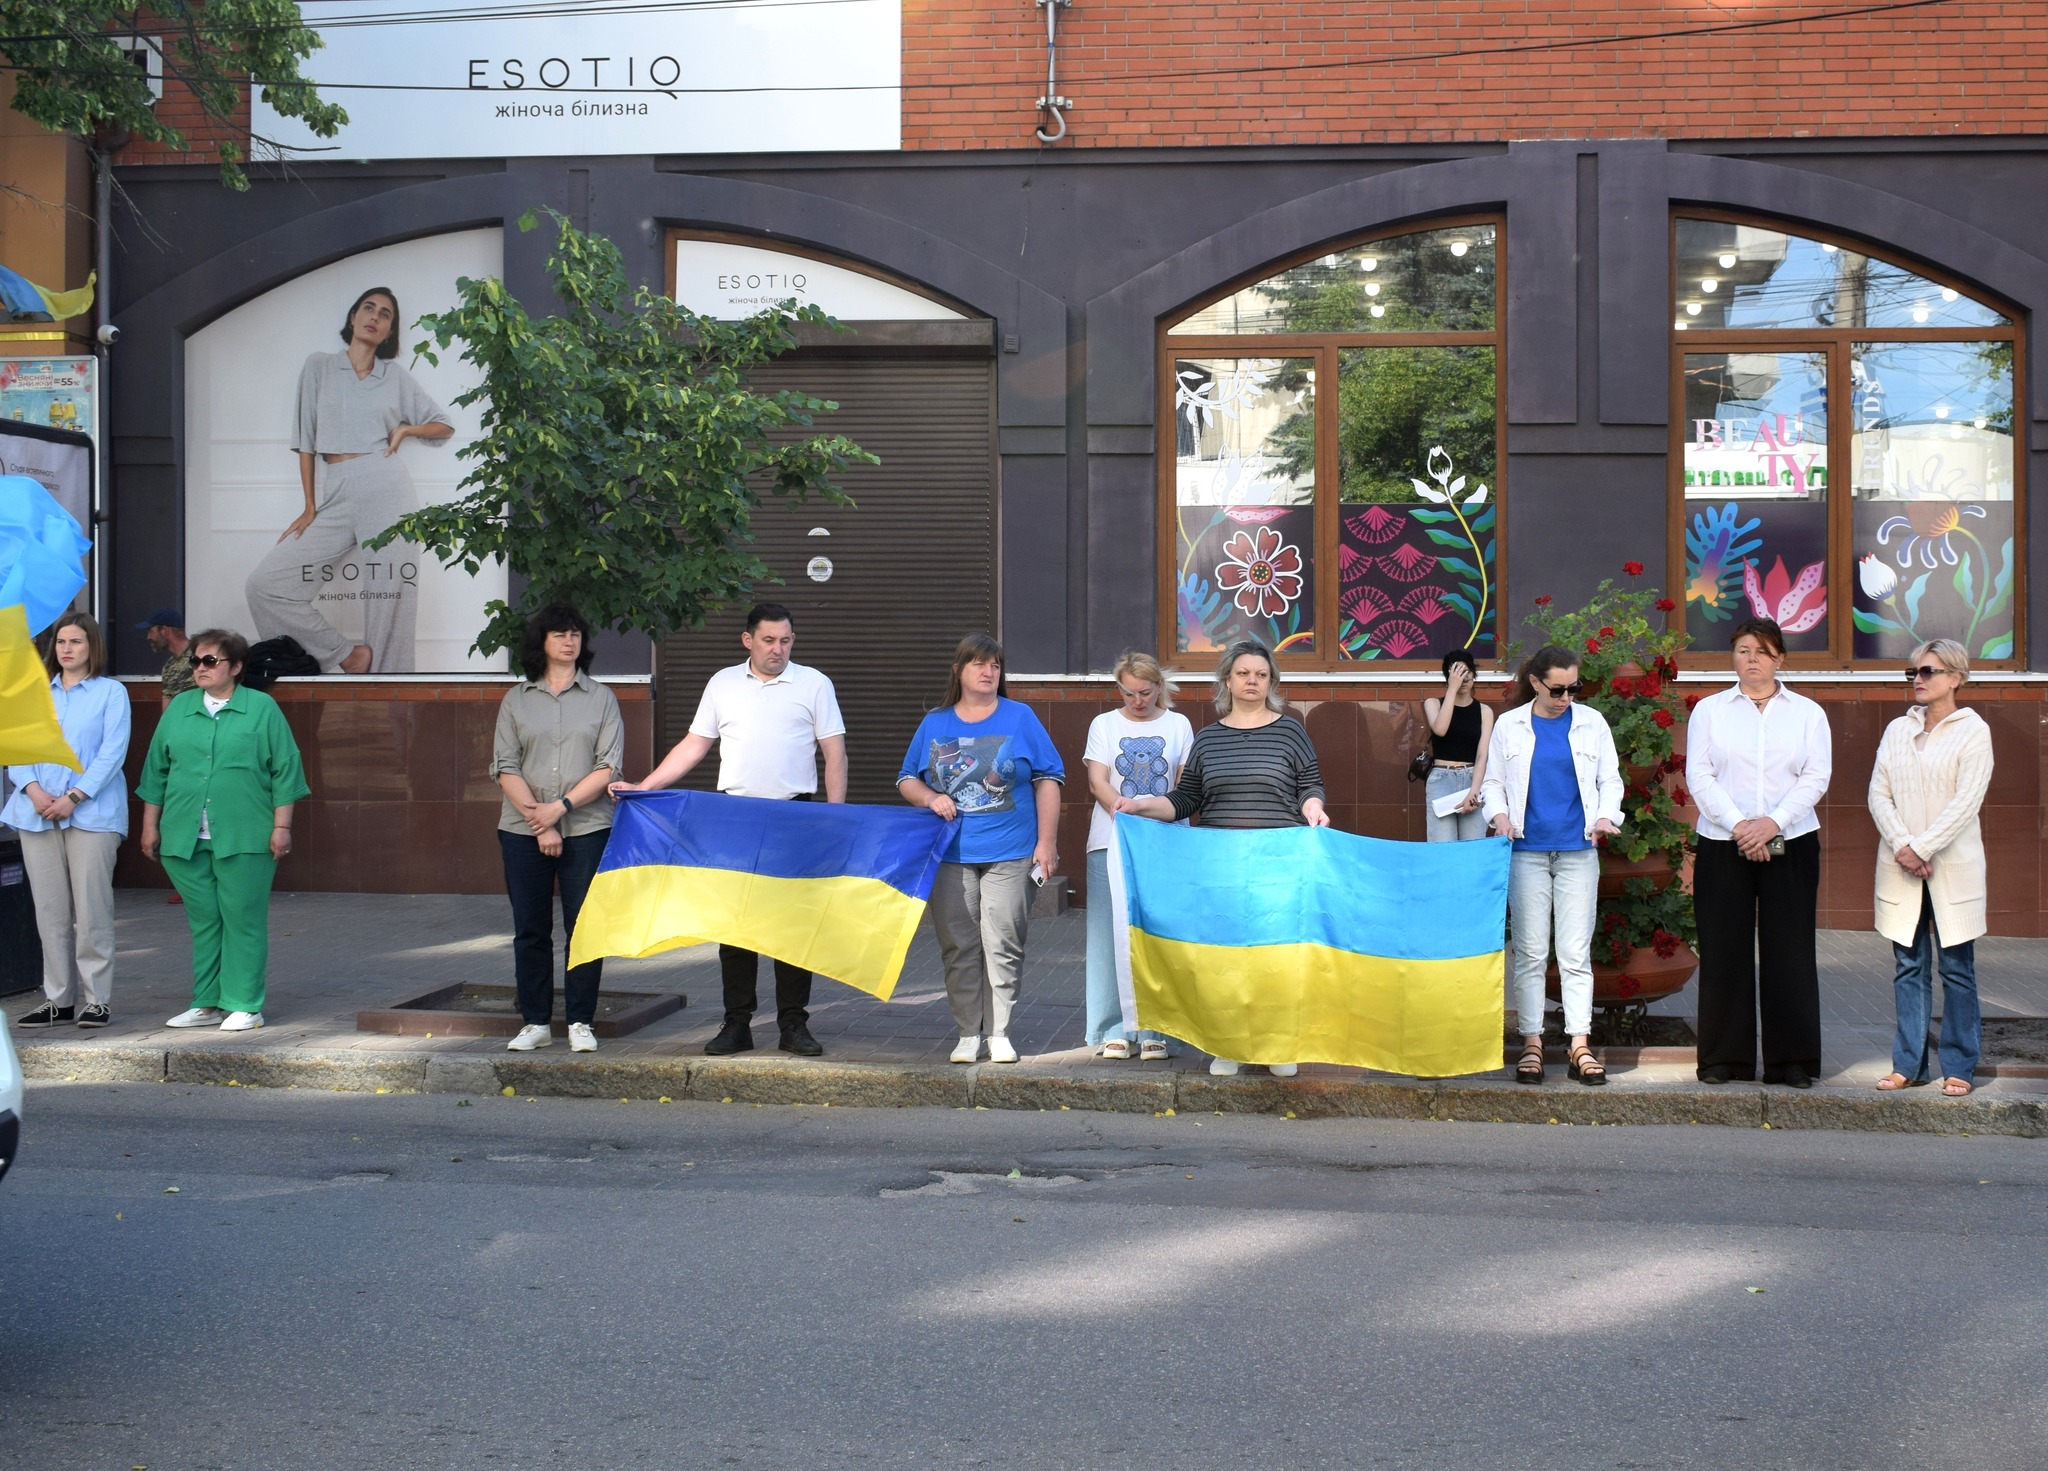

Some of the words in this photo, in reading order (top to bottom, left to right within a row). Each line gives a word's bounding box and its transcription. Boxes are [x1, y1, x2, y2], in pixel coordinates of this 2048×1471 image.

[469, 55, 681, 100] ESOTIQ
[495, 101, 564, 118] жіноча
[571, 99, 649, 117] білизна
[718, 274, 807, 294] ESOTIQ
[728, 296, 758, 305] жіноча
[760, 295, 803, 305] білиз
[1691, 413, 1805, 452] BEAU
[1862, 377, 1882, 489] TRENDS
[1757, 453, 1820, 494] TY
[301, 562, 418, 588] ESOTIQ
[318, 592, 357, 602] жіноча
[360, 590, 402, 600] білизна
